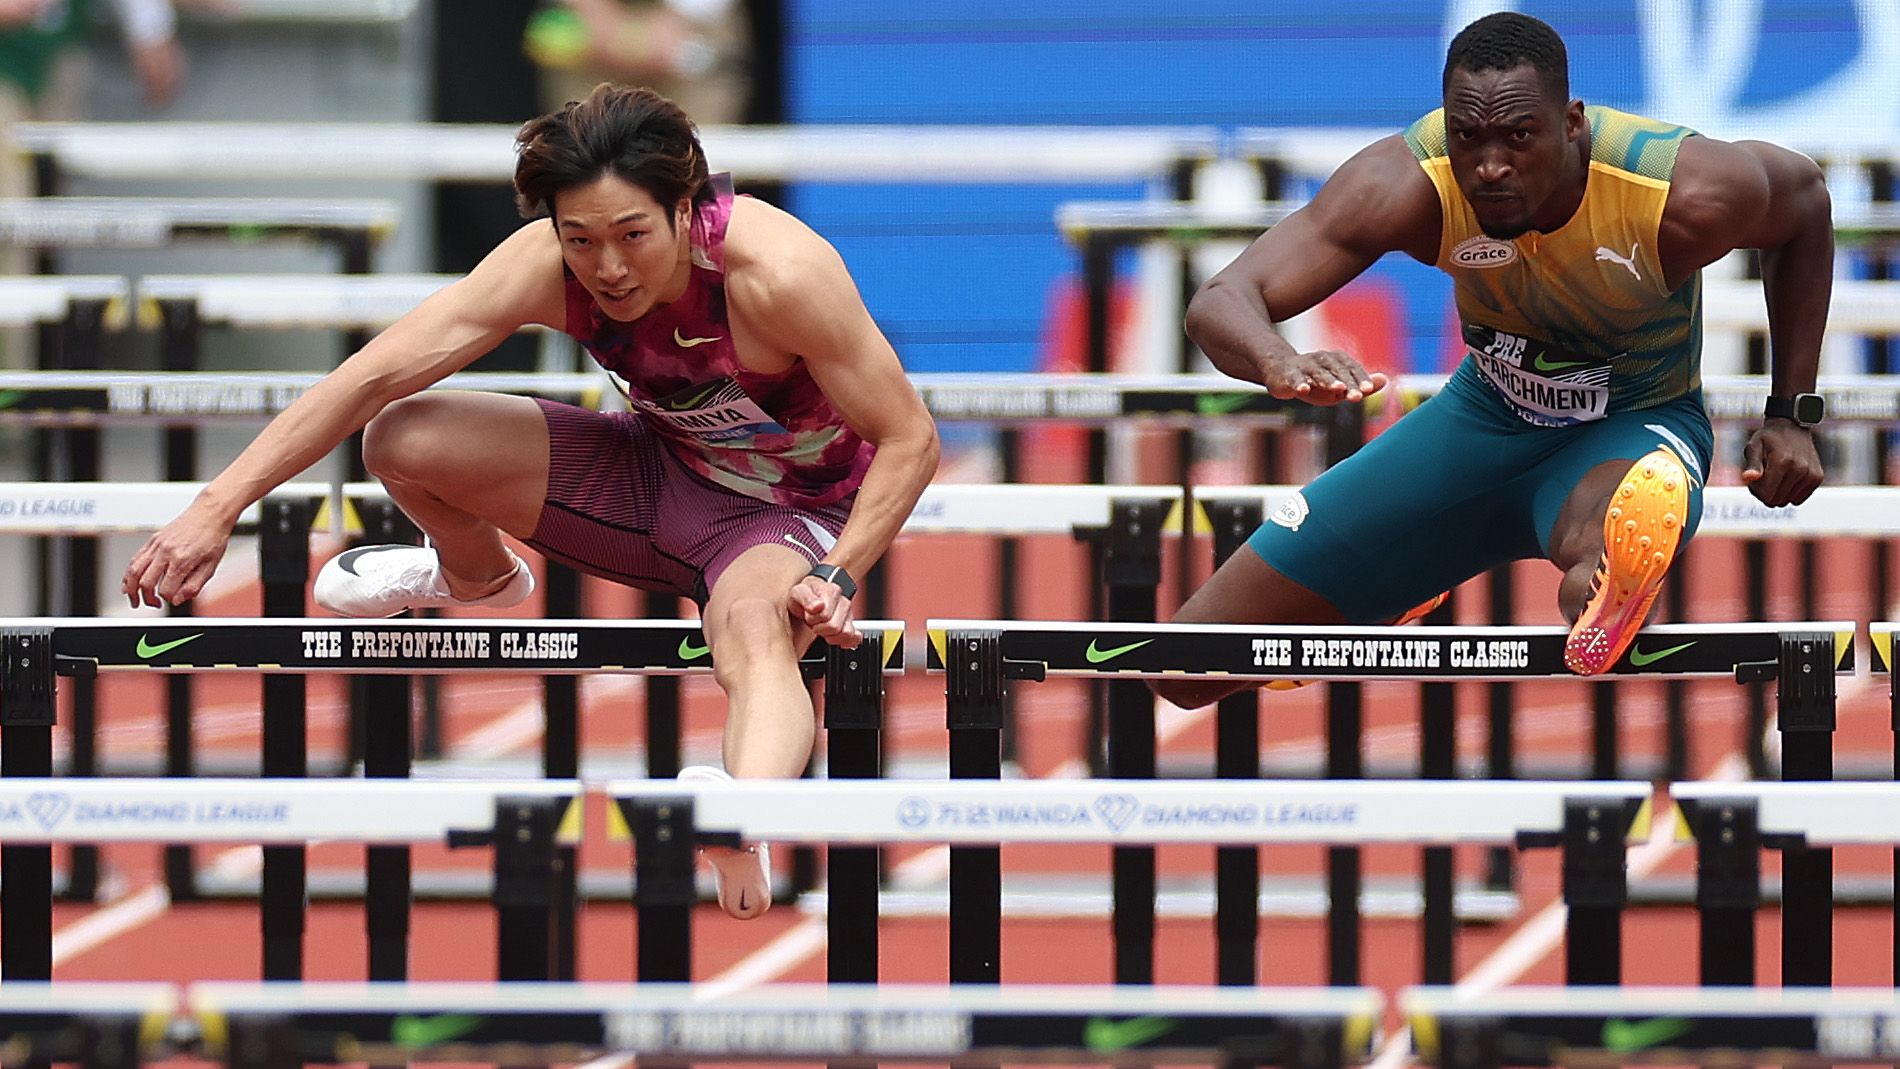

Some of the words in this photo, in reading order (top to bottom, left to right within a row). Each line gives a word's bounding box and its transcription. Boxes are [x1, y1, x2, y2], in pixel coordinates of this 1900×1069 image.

[1459, 248, 1507, 261] Grace
[1484, 331, 1528, 367] PRE
[1479, 355, 1601, 413] PARCHMENT
[20, 499, 97, 515] LEAGUE
[301, 631, 342, 659] THE
[351, 631, 491, 660] PREFONTAINE
[500, 632, 579, 660] CLASSIC
[1251, 638, 1292, 667] THE
[1301, 639, 1441, 668] PREFONTAINE
[1450, 640, 1529, 668] CLASSIC
[996, 803, 1093, 824] WANDA
[1142, 803, 1258, 825] DIAMOND
[1264, 803, 1358, 825] LEAGUE
